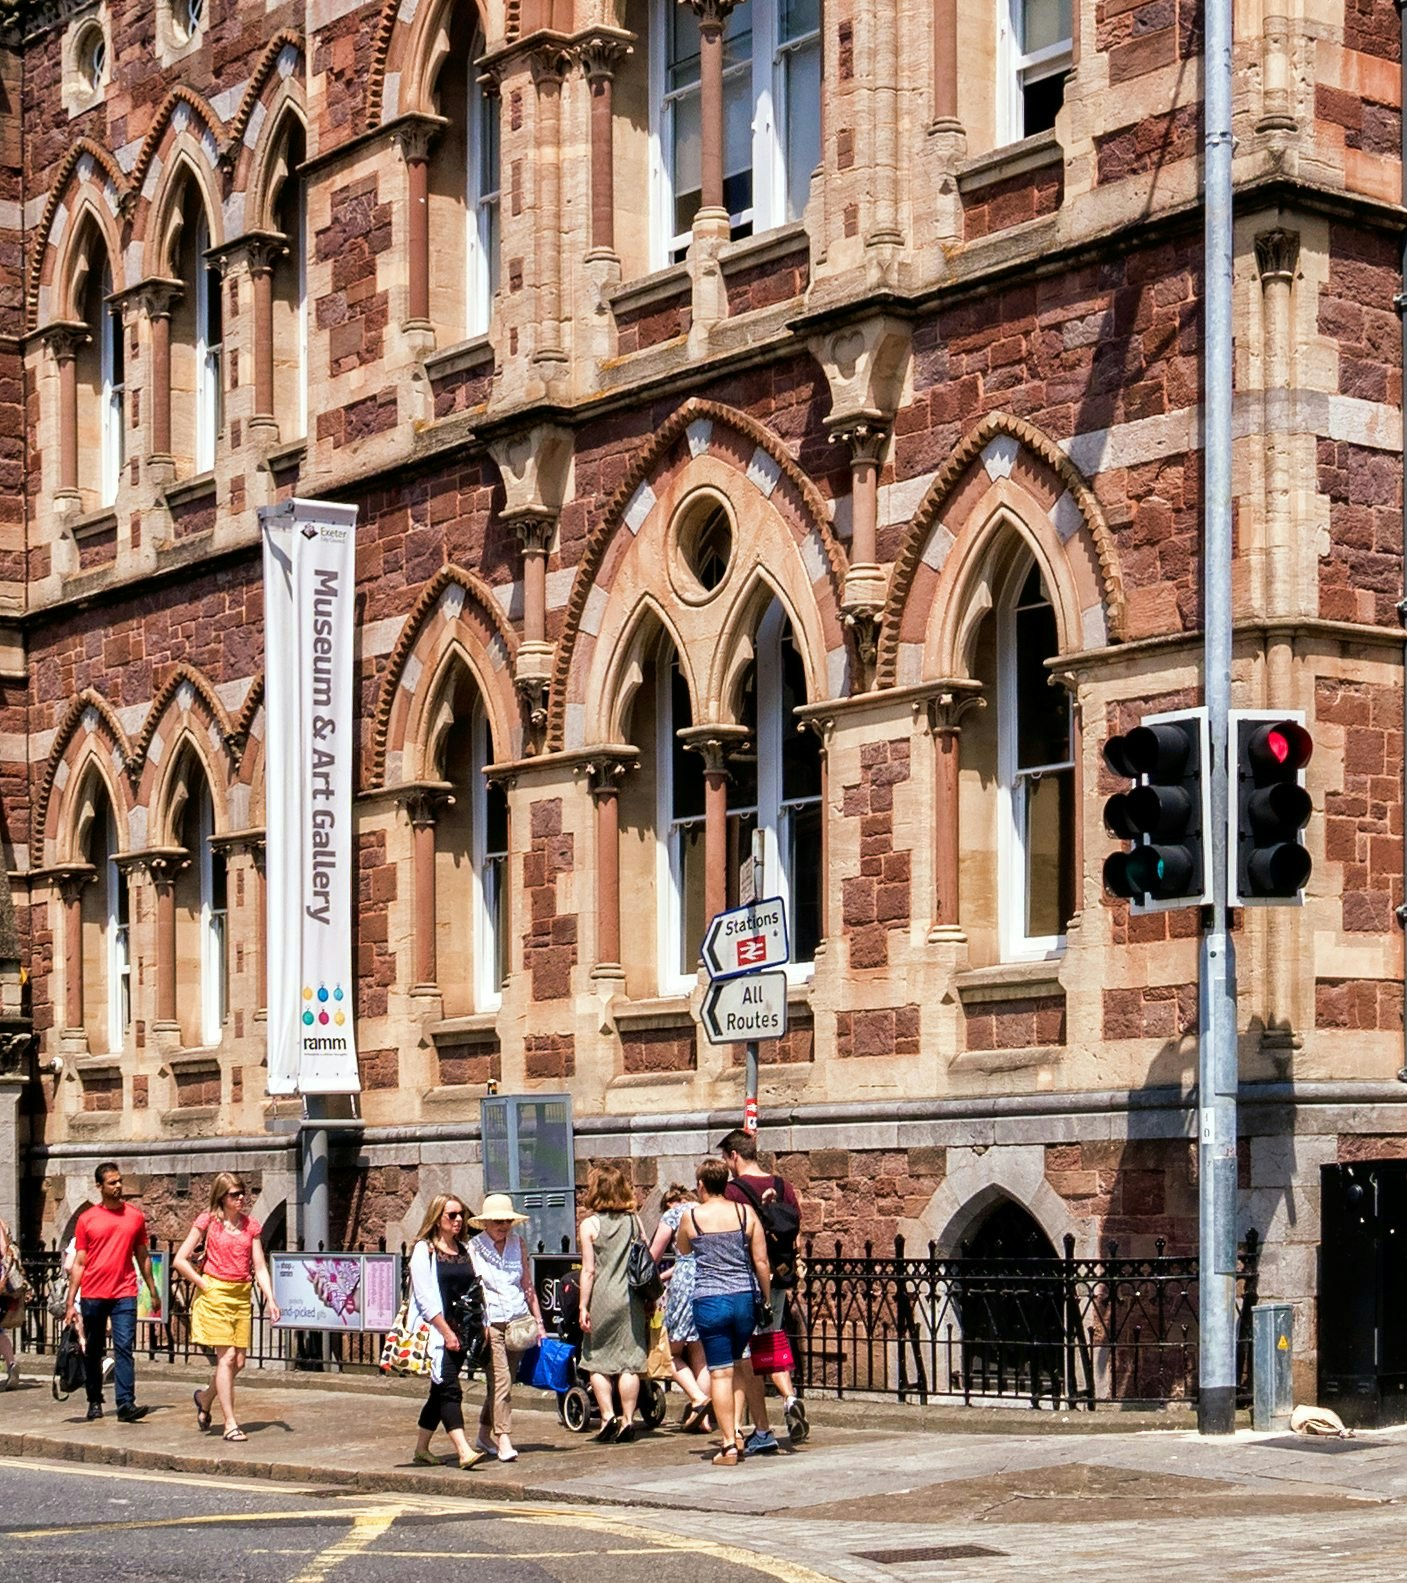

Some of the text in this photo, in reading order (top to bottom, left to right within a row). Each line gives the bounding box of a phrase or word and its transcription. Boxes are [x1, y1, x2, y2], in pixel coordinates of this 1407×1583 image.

[320, 526, 347, 538] Exeter
[305, 568, 339, 926] Museum & Art Gallery
[725, 910, 780, 937] Stations
[742, 985, 764, 1005] All
[726, 1012, 779, 1032] Routes
[303, 1037, 347, 1050] ramm
[278, 1306, 316, 1319] and-picked
